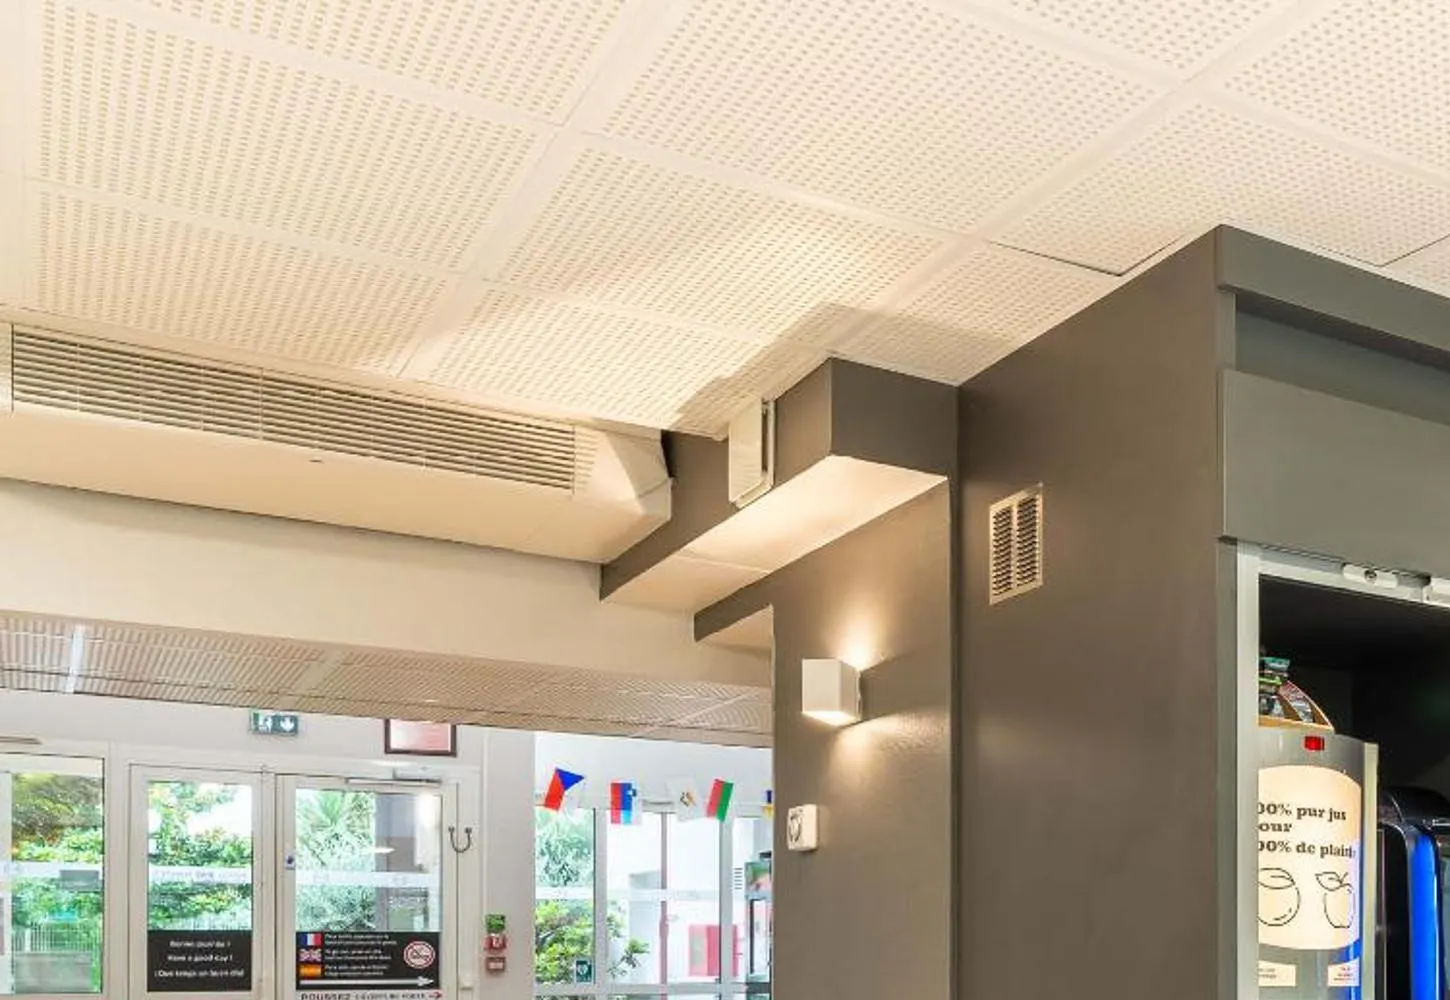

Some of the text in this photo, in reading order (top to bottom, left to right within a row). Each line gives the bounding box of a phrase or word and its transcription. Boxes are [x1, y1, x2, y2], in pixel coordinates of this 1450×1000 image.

[1258, 801, 1347, 823] 00% pur jus
[1258, 822, 1293, 833] our
[1258, 840, 1292, 853] 00%
[1296, 842, 1316, 854] de
